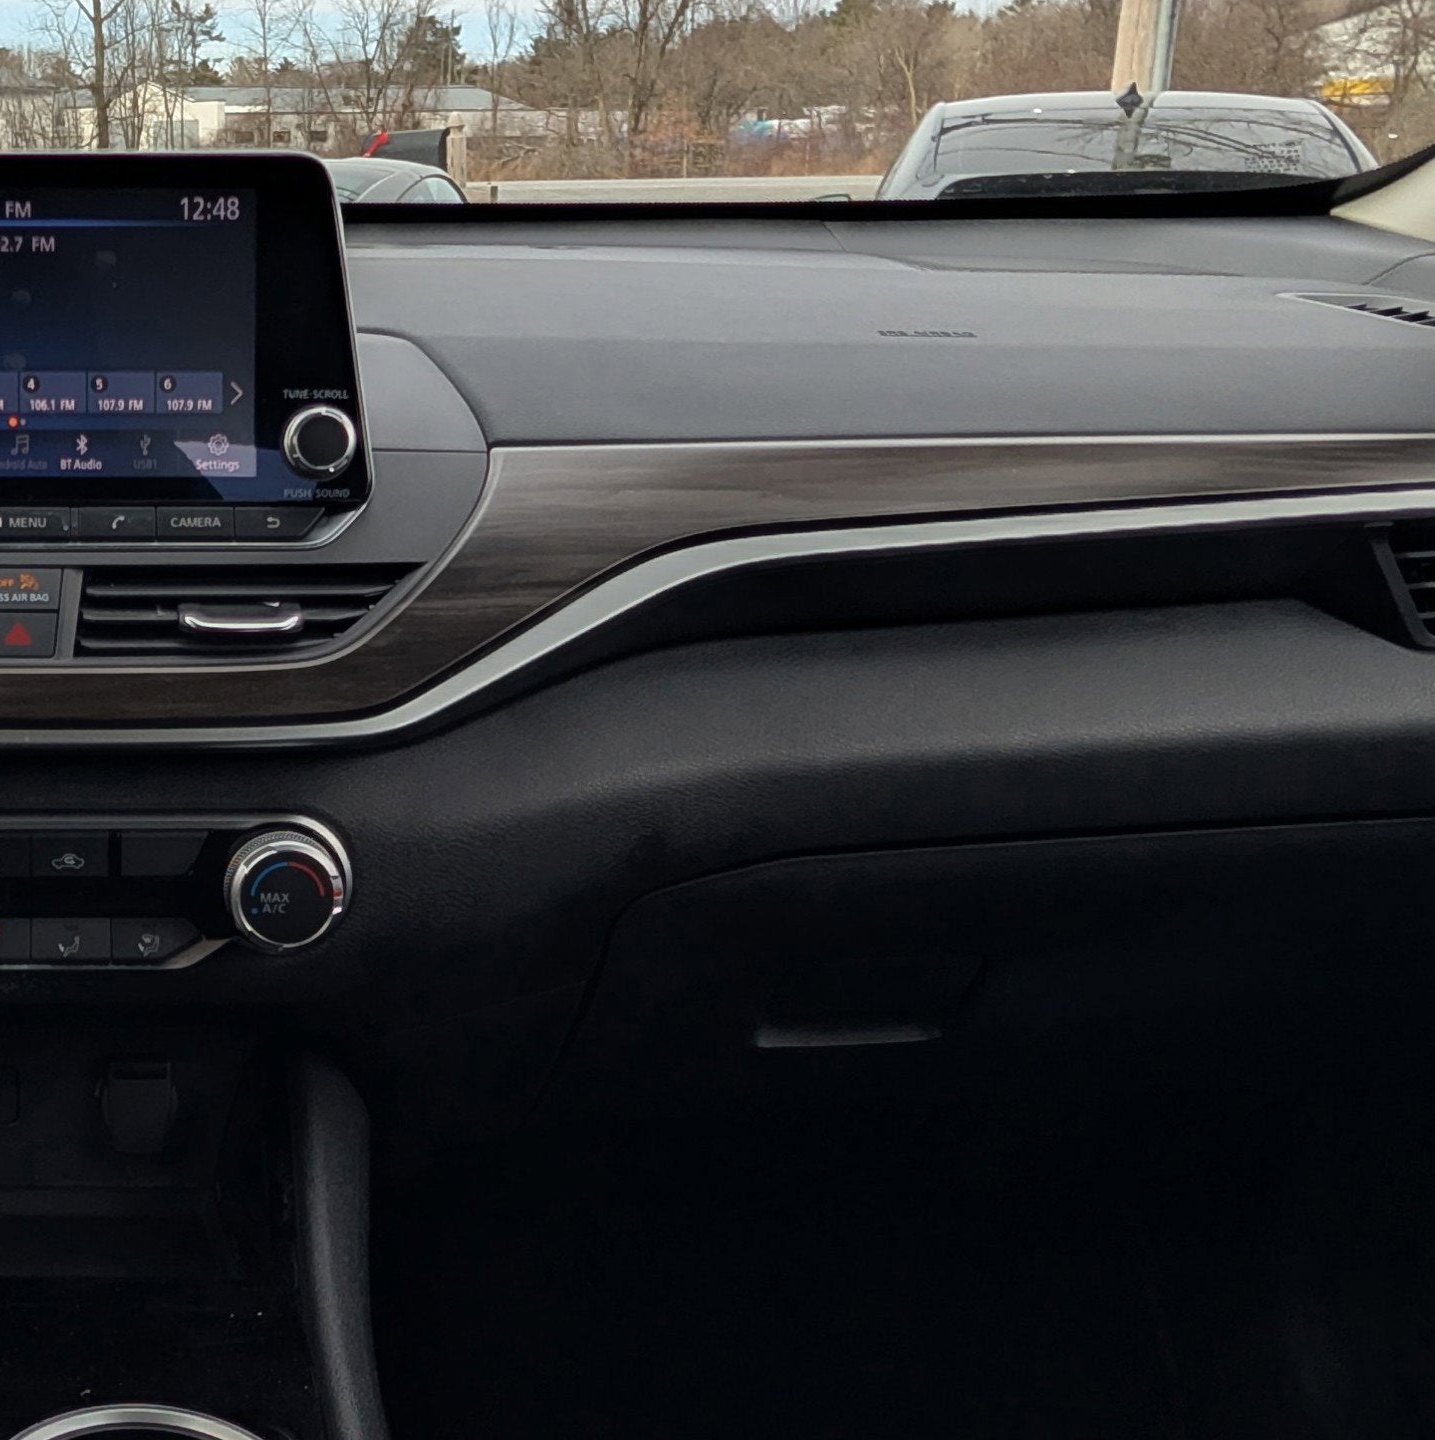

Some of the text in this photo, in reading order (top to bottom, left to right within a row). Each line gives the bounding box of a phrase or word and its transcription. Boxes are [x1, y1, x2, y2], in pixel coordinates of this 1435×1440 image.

[5, 201, 32, 218] FM
[179, 196, 241, 221] 12:48
[32, 236, 56, 252] FM
[27, 378, 35, 390] 4
[95, 378, 103, 390] 5
[164, 378, 171, 390] 6
[29, 399, 75, 411] 106.1 FM
[98, 399, 143, 411] 107.9 FM
[167, 399, 212, 411] 107.9 FM
[60, 459, 103, 471] BT Audio
[196, 459, 240, 472] Settings
[284, 488, 350, 499] PUSH SOUND
[8, 516, 47, 529] MENU
[169, 515, 222, 529] CAMERA
[12, 593, 28, 603] AIR
[29, 593, 50, 603] BAG
[259, 893, 291, 904] MAX
[261, 903, 287, 915] A/C
